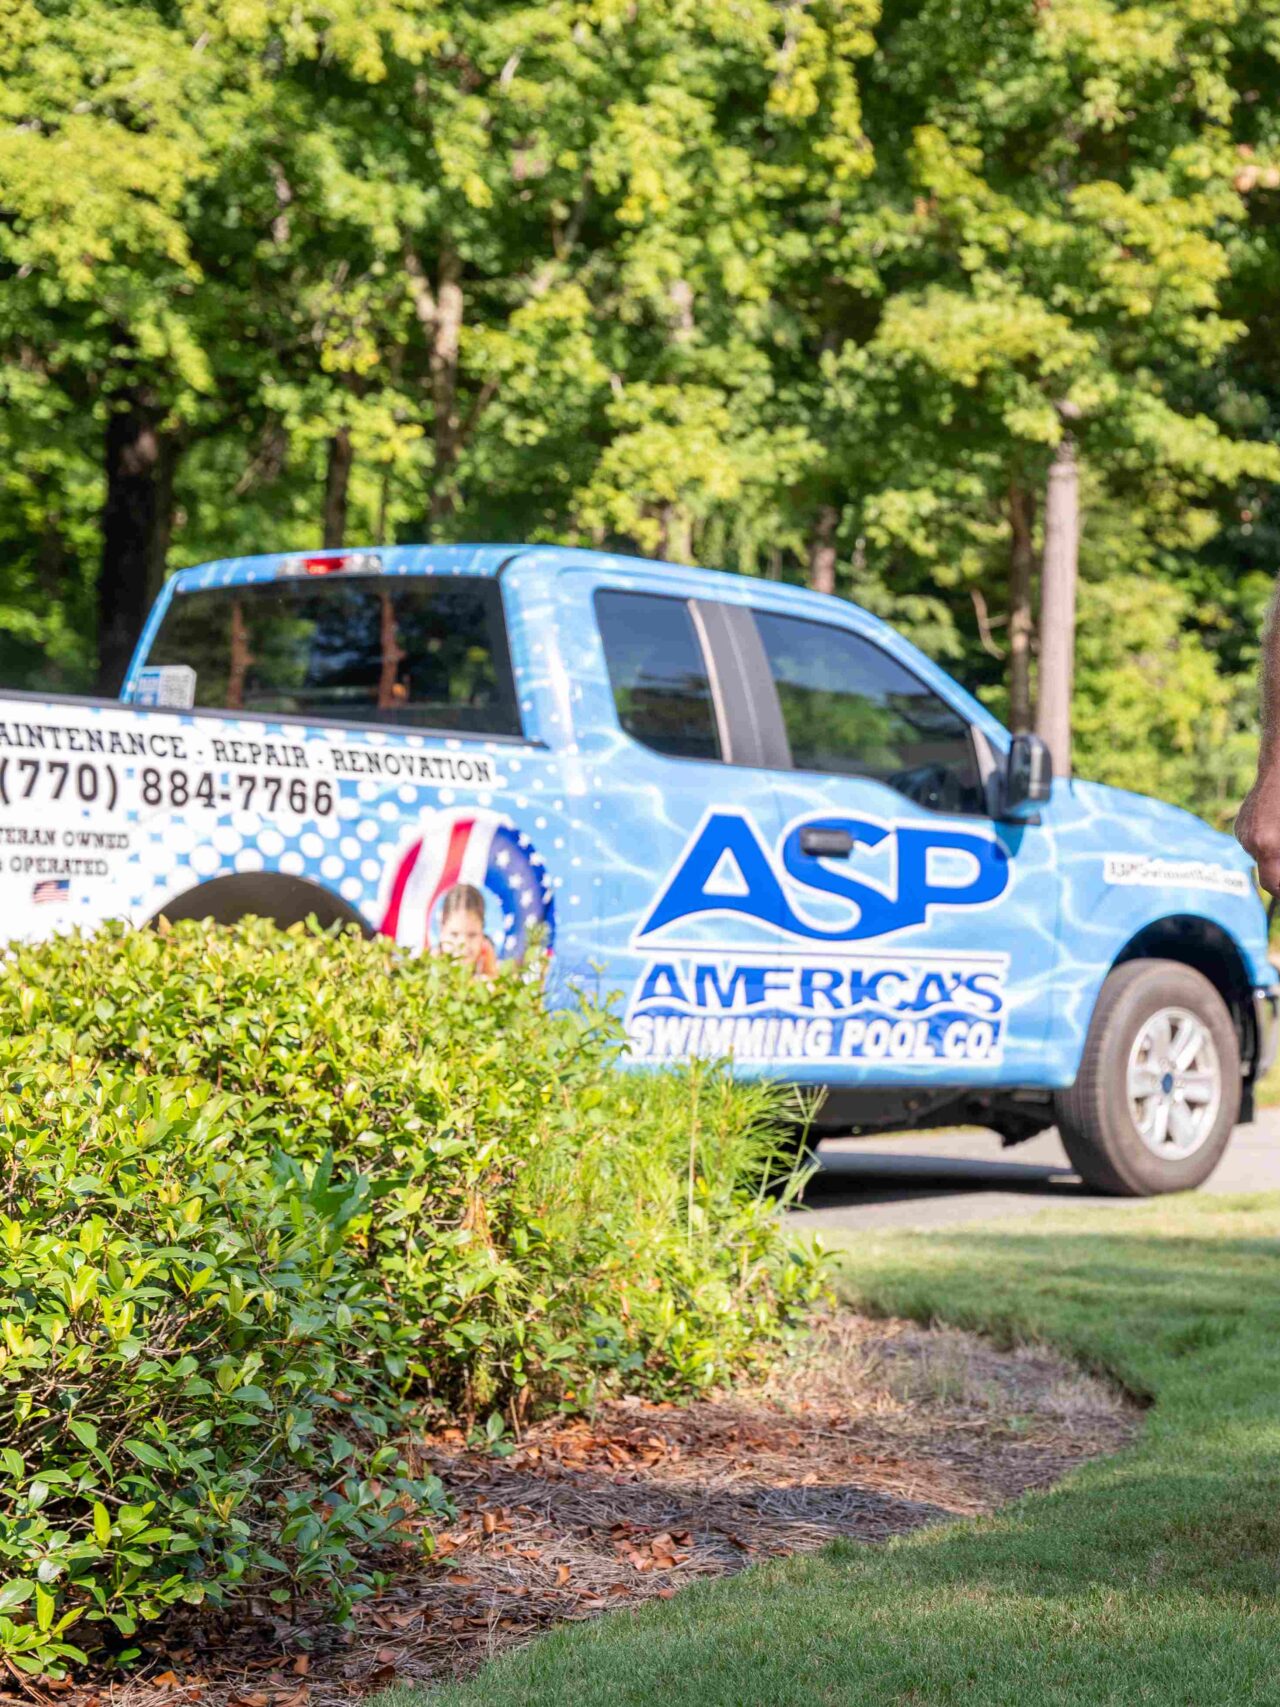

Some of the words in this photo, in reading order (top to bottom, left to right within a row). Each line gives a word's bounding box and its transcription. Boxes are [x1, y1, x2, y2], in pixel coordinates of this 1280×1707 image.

[0, 722, 188, 760] AINTENANCE
[211, 738, 310, 769] REPAIR
[331, 748, 492, 782] RENOVATION
[0, 757, 119, 812] (770)
[142, 767, 333, 817] 884-7766
[9, 855, 109, 877] OPERATED
[62, 830, 130, 850] OWNED
[637, 812, 1009, 941] ASP
[638, 962, 1004, 1015] AMERICA'S
[630, 1015, 835, 1059] SWIMMING
[841, 1017, 936, 1058] POOL
[943, 1020, 1000, 1059] CO.
